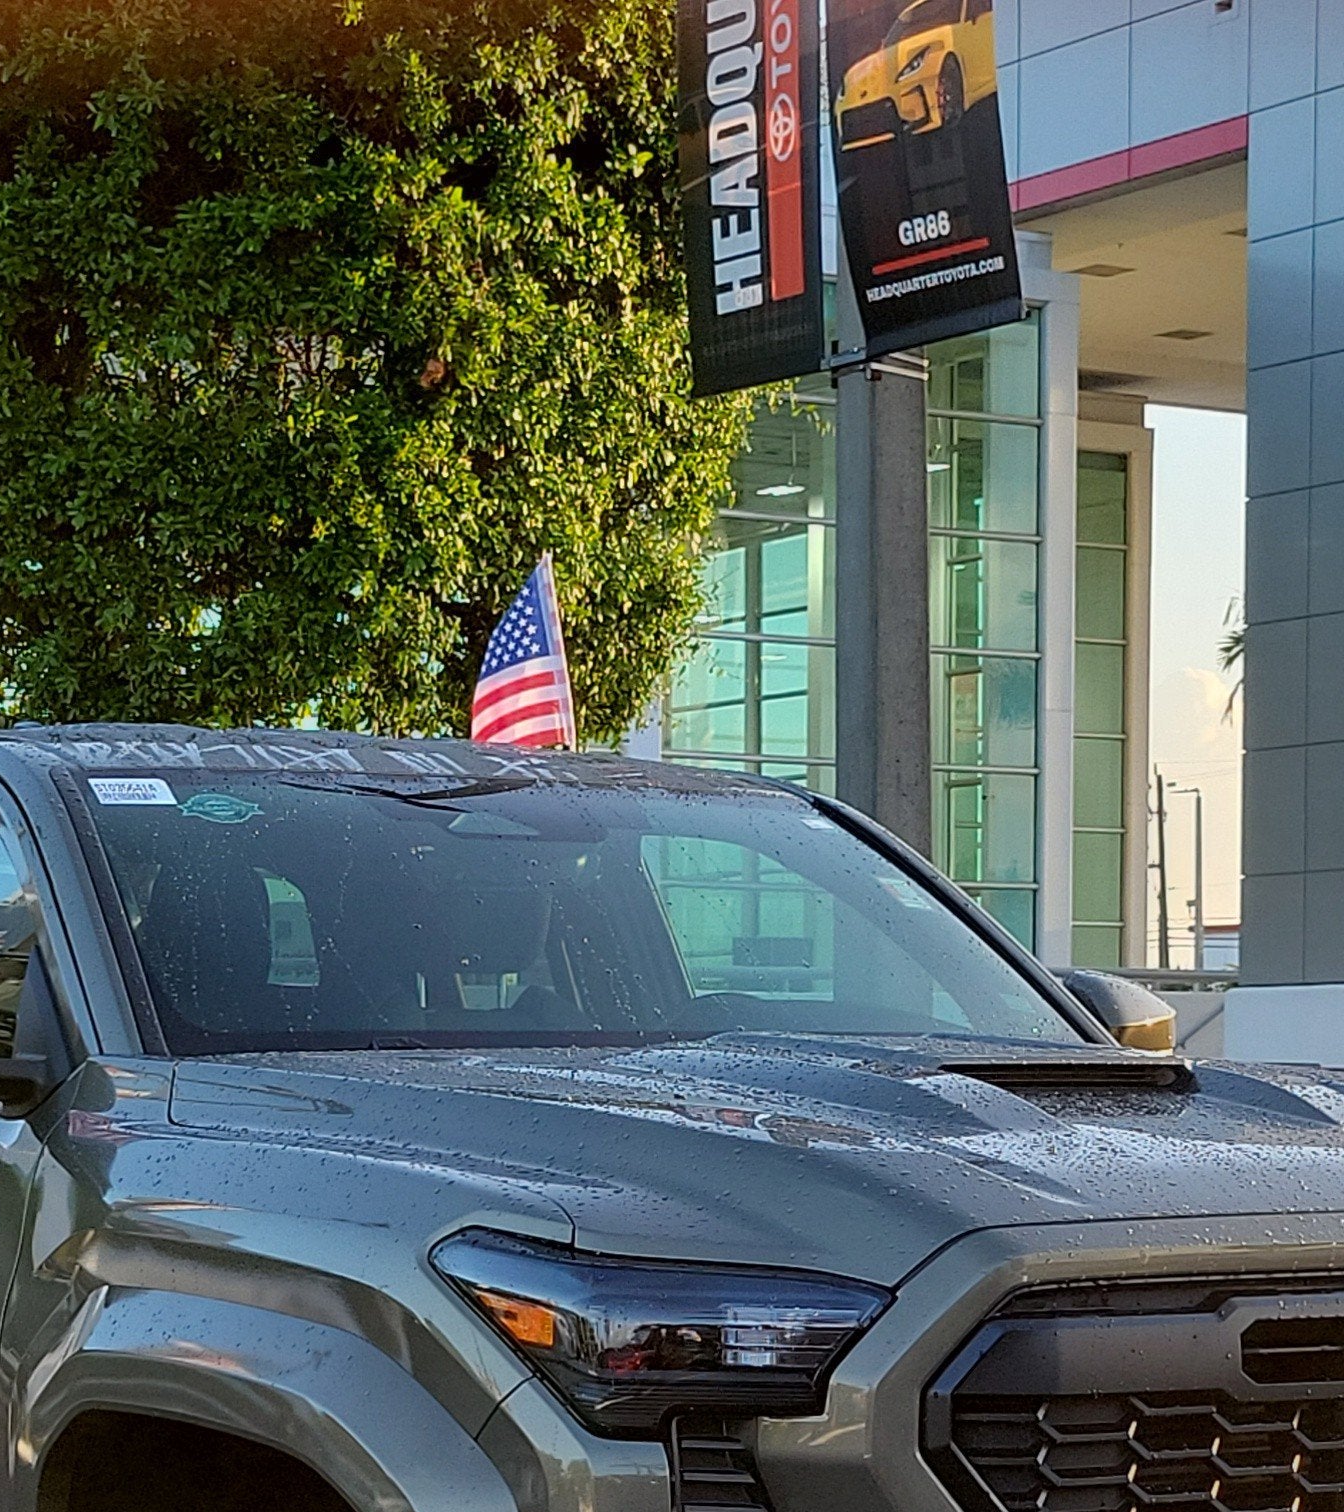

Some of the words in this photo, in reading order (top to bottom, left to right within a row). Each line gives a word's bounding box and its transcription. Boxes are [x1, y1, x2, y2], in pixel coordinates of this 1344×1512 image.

[770, 0, 793, 90] TO
[707, 0, 763, 316] HEADQU
[898, 210, 951, 246] GR86
[865, 256, 1005, 303] HEADQUARTERTOYOTA.COM
